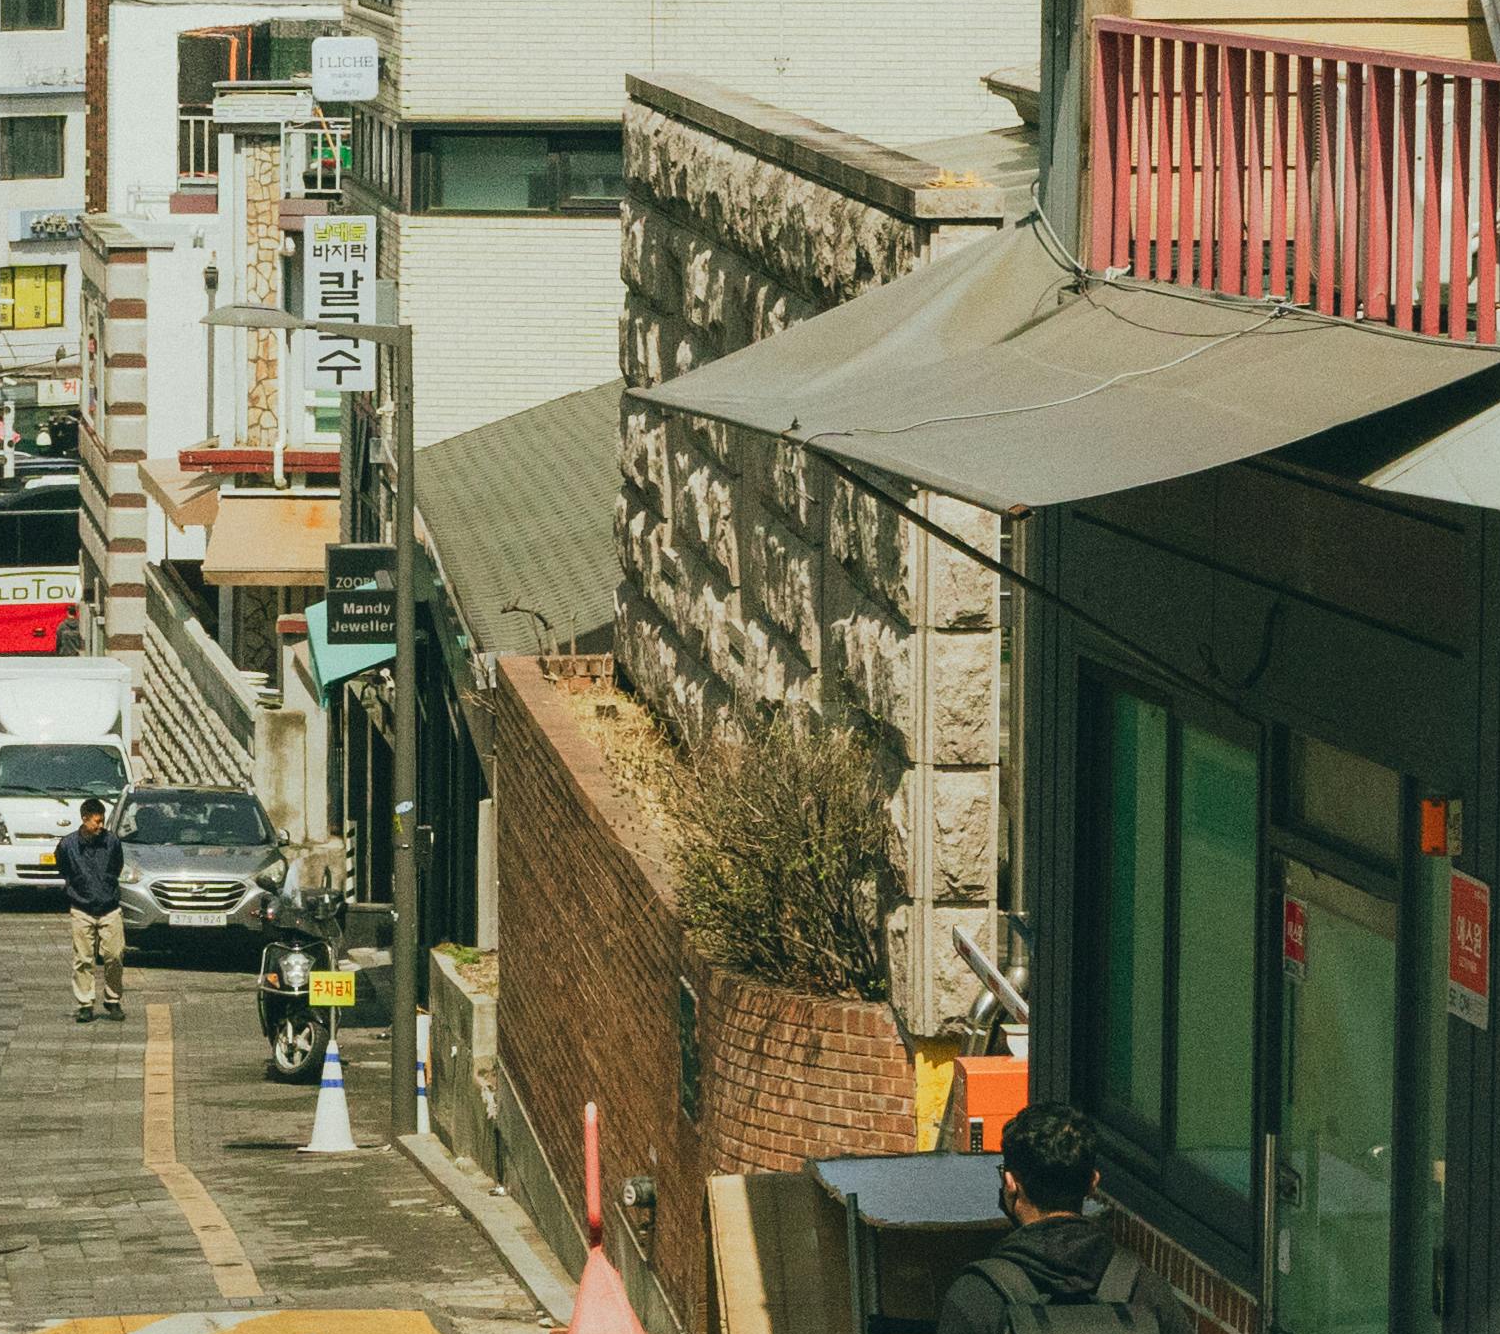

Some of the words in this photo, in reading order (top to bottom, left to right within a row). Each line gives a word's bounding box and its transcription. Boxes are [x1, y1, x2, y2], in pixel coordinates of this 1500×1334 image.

[313, 222, 367, 242] 남대문
[313, 244, 368, 263] 바지락
[343, 602, 391, 615] Mandy
[331, 620, 395, 633] Jeweller
